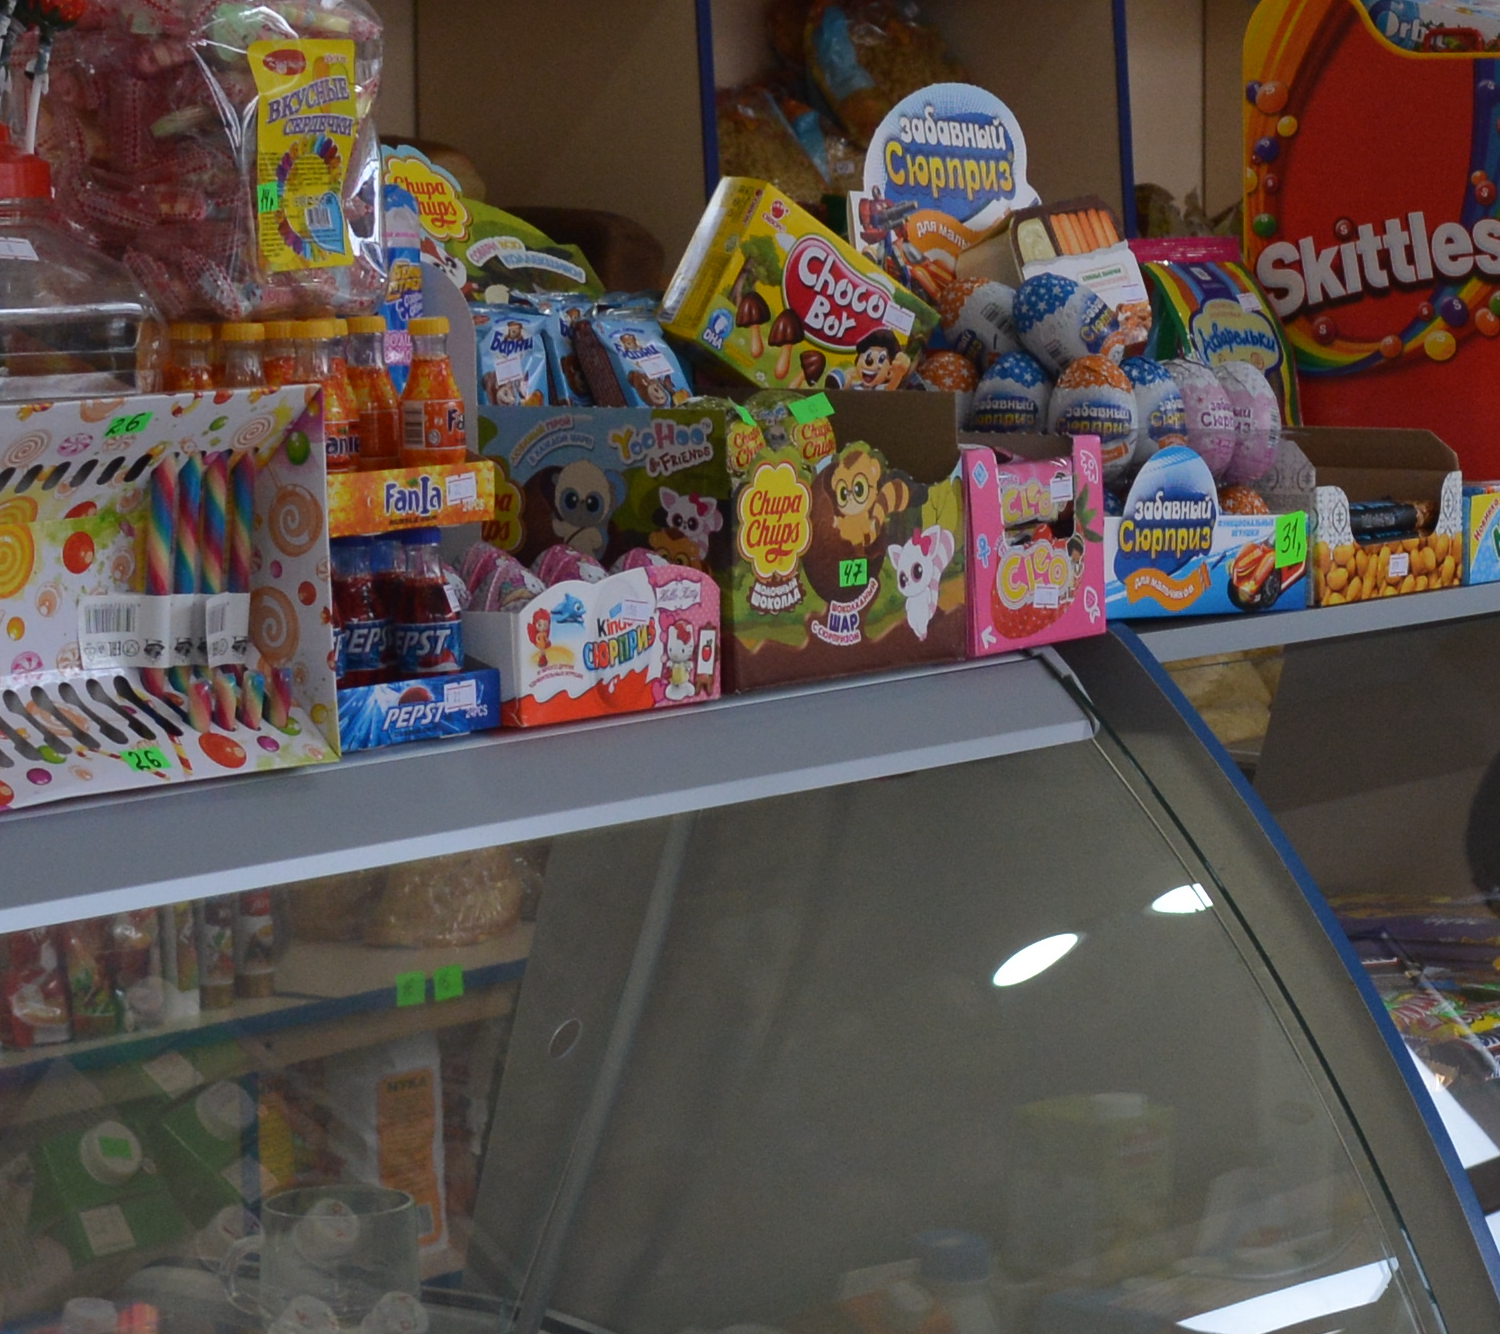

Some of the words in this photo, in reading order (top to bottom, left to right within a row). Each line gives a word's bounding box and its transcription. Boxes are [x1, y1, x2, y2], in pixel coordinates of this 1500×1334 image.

[267, 76, 350, 125] ВКУСНЫЕ
[899, 108, 1005, 150] забавный
[394, 176, 446, 198] Chupa
[885, 143, 1013, 198] Сюрприз
[798, 247, 887, 321] Choco
[807, 301, 855, 341] Boy
[611, 422, 706, 459] YooHoo
[749, 491, 802, 517] Chupa
[1134, 491, 1214, 520] забавный
[747, 520, 801, 563] Chups
[1119, 518, 1213, 558] Сюрприз
[843, 562, 864, 584] 47
[828, 615, 860, 632] ШАР
